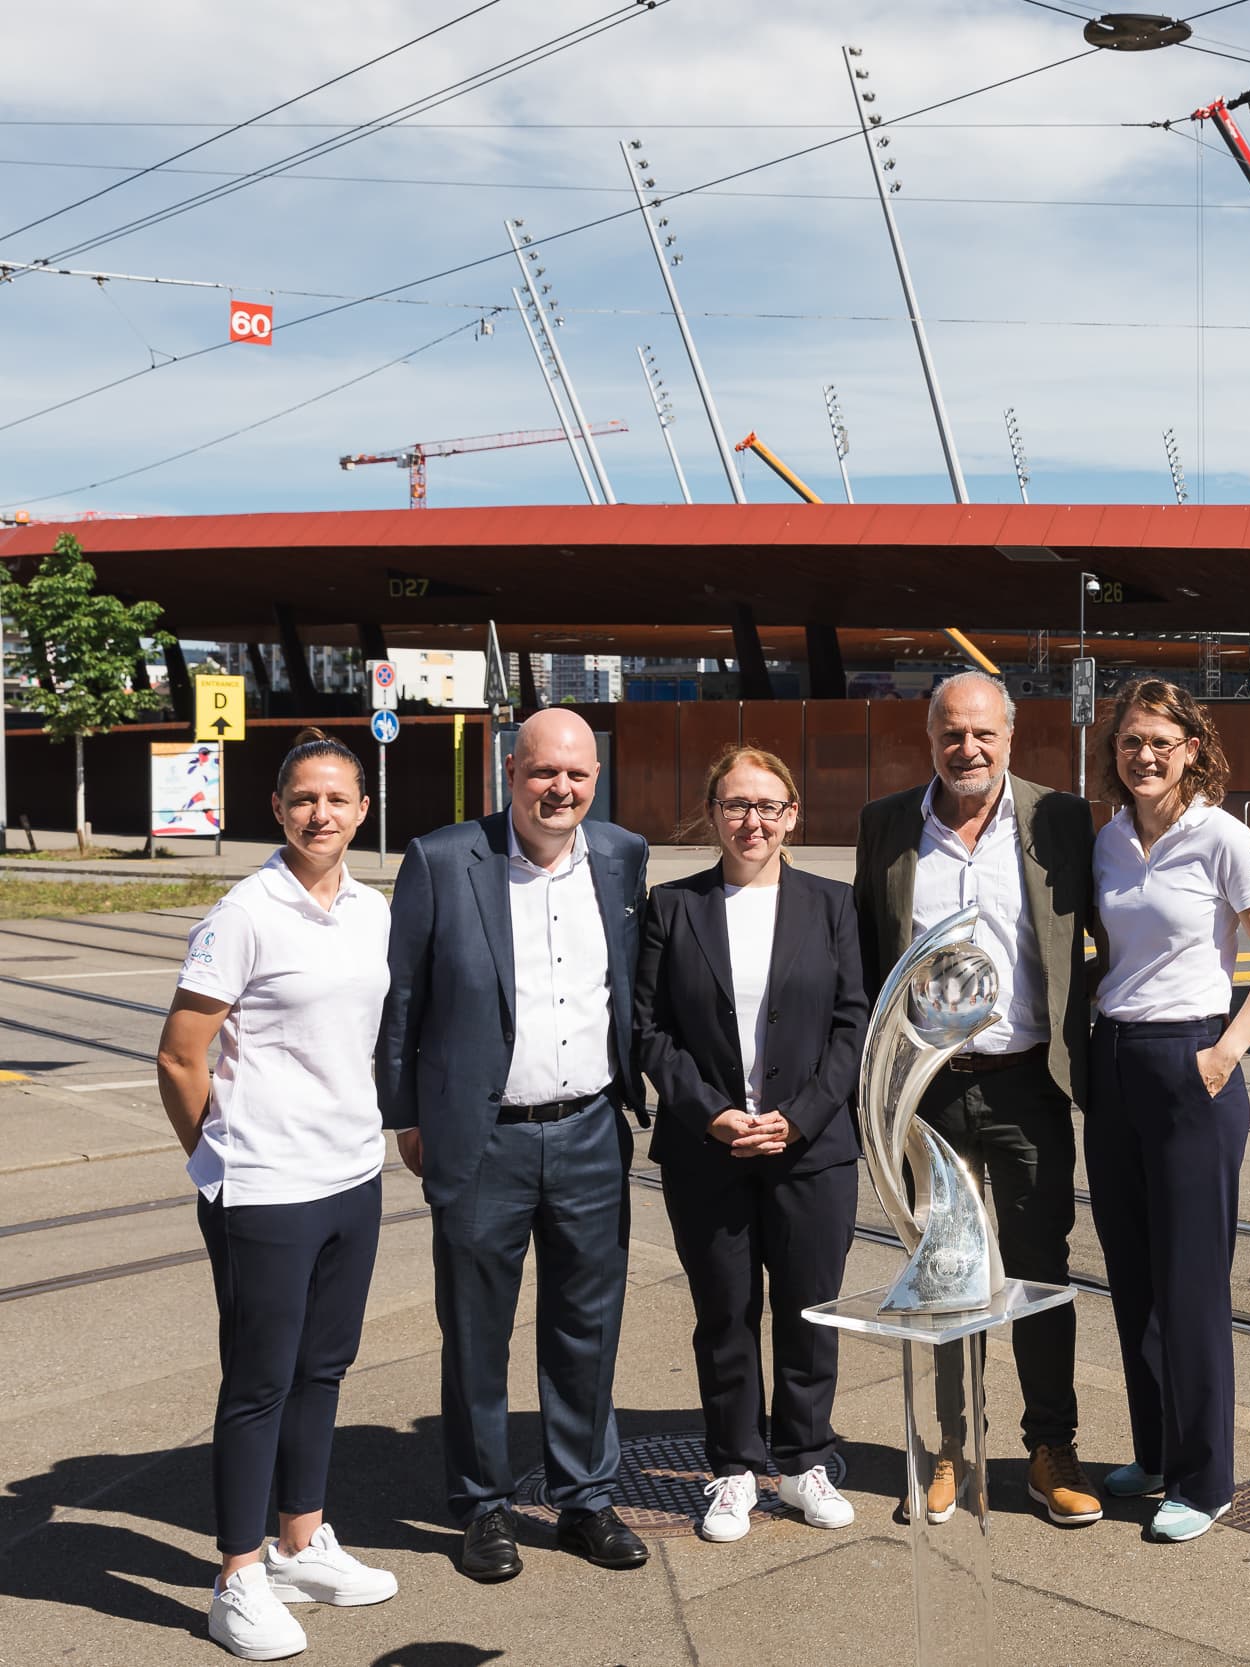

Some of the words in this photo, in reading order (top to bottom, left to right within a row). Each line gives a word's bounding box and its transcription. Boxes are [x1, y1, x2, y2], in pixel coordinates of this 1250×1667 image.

[231, 310, 271, 338] 60
[390, 579, 429, 597] D27
[201, 680, 240, 688] ENTRANCE
[215, 692, 227, 709] D
